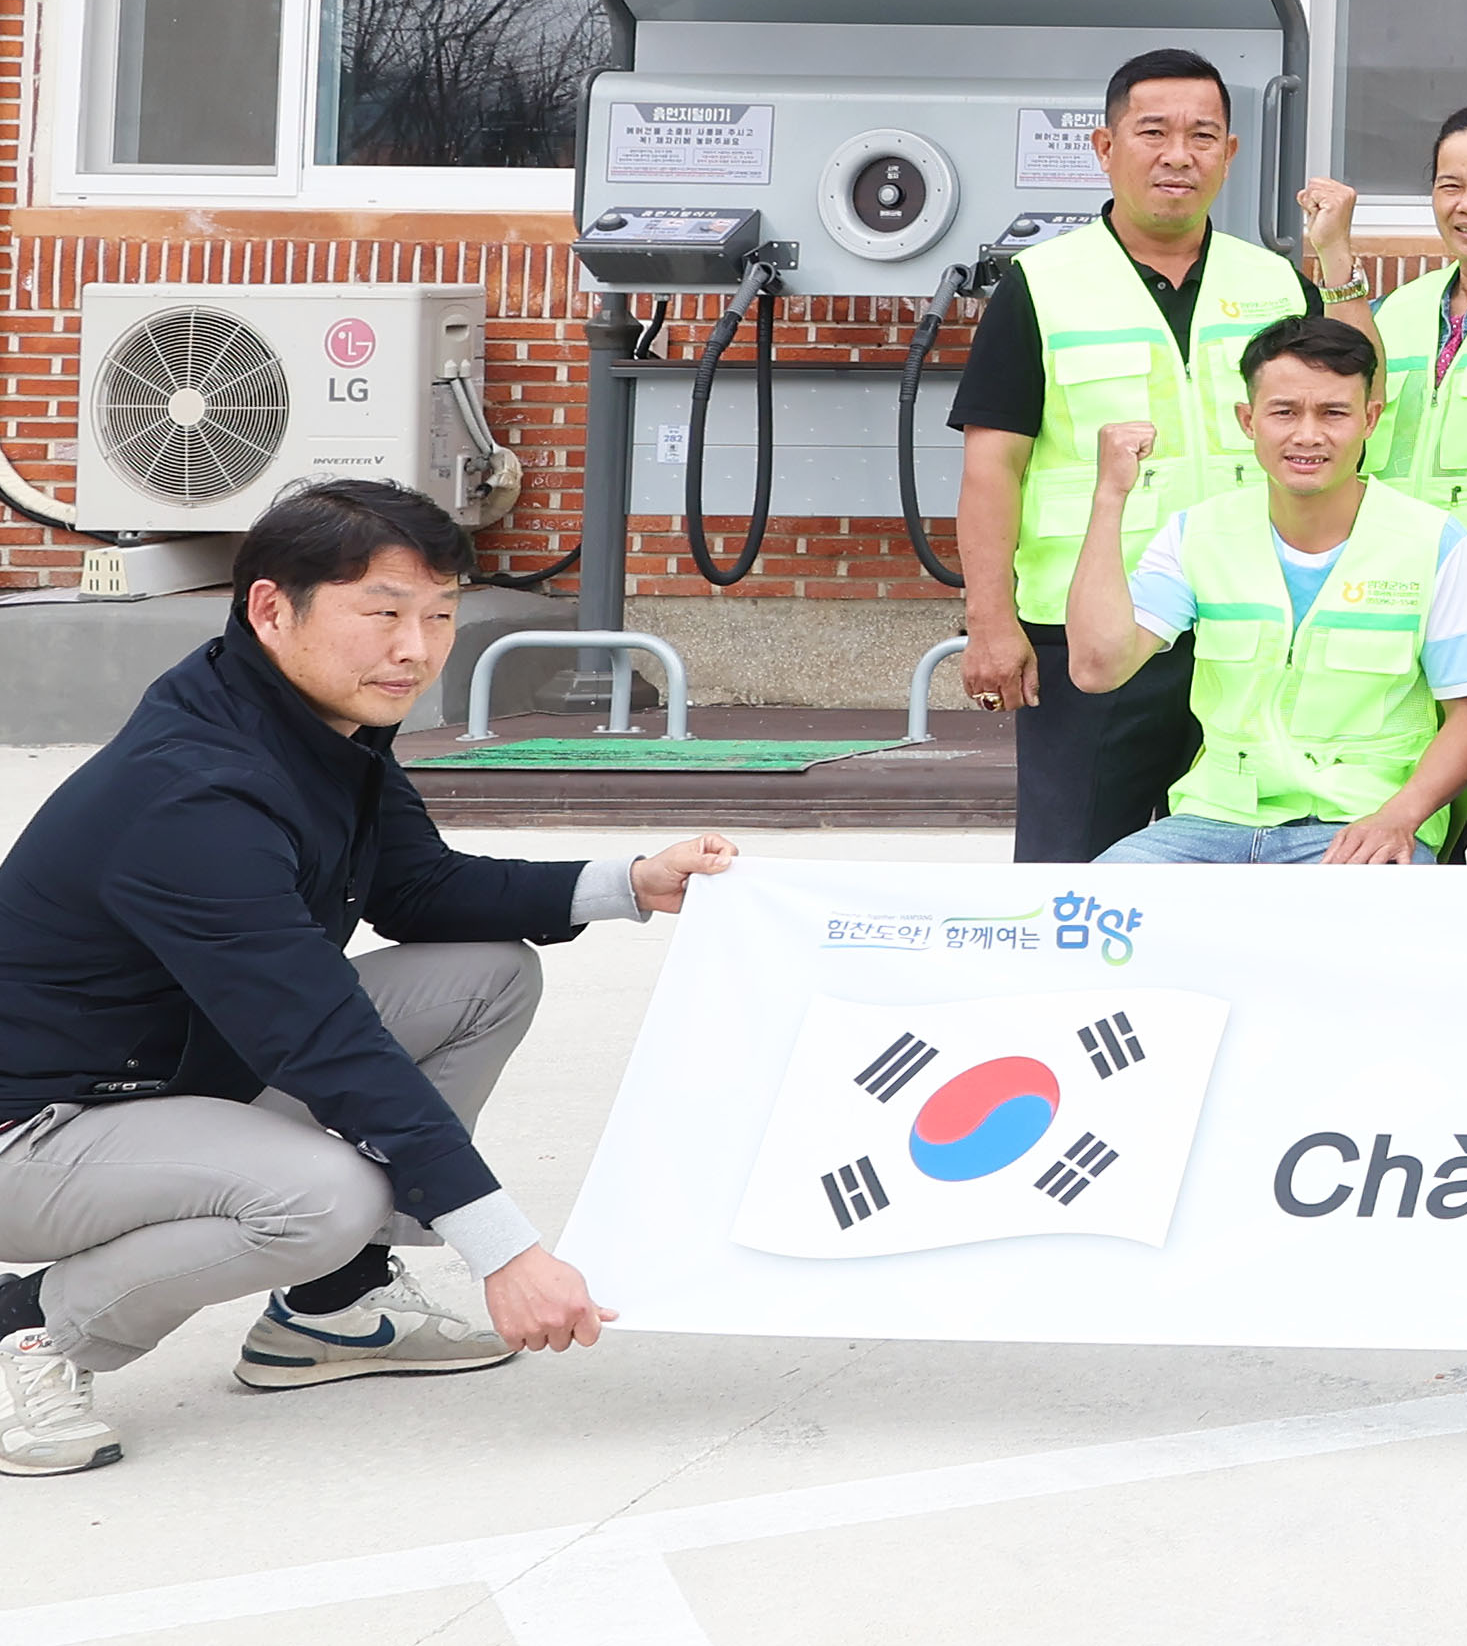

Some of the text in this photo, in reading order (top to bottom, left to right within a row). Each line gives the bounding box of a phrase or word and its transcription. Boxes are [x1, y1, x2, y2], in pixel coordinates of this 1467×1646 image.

[653, 106, 731, 122] 흙먼지털이기
[328, 377, 370, 403] LG
[313, 457, 373, 465] INVERTER
[827, 890, 1144, 966] 힘찬도약! 함께여는 함양
